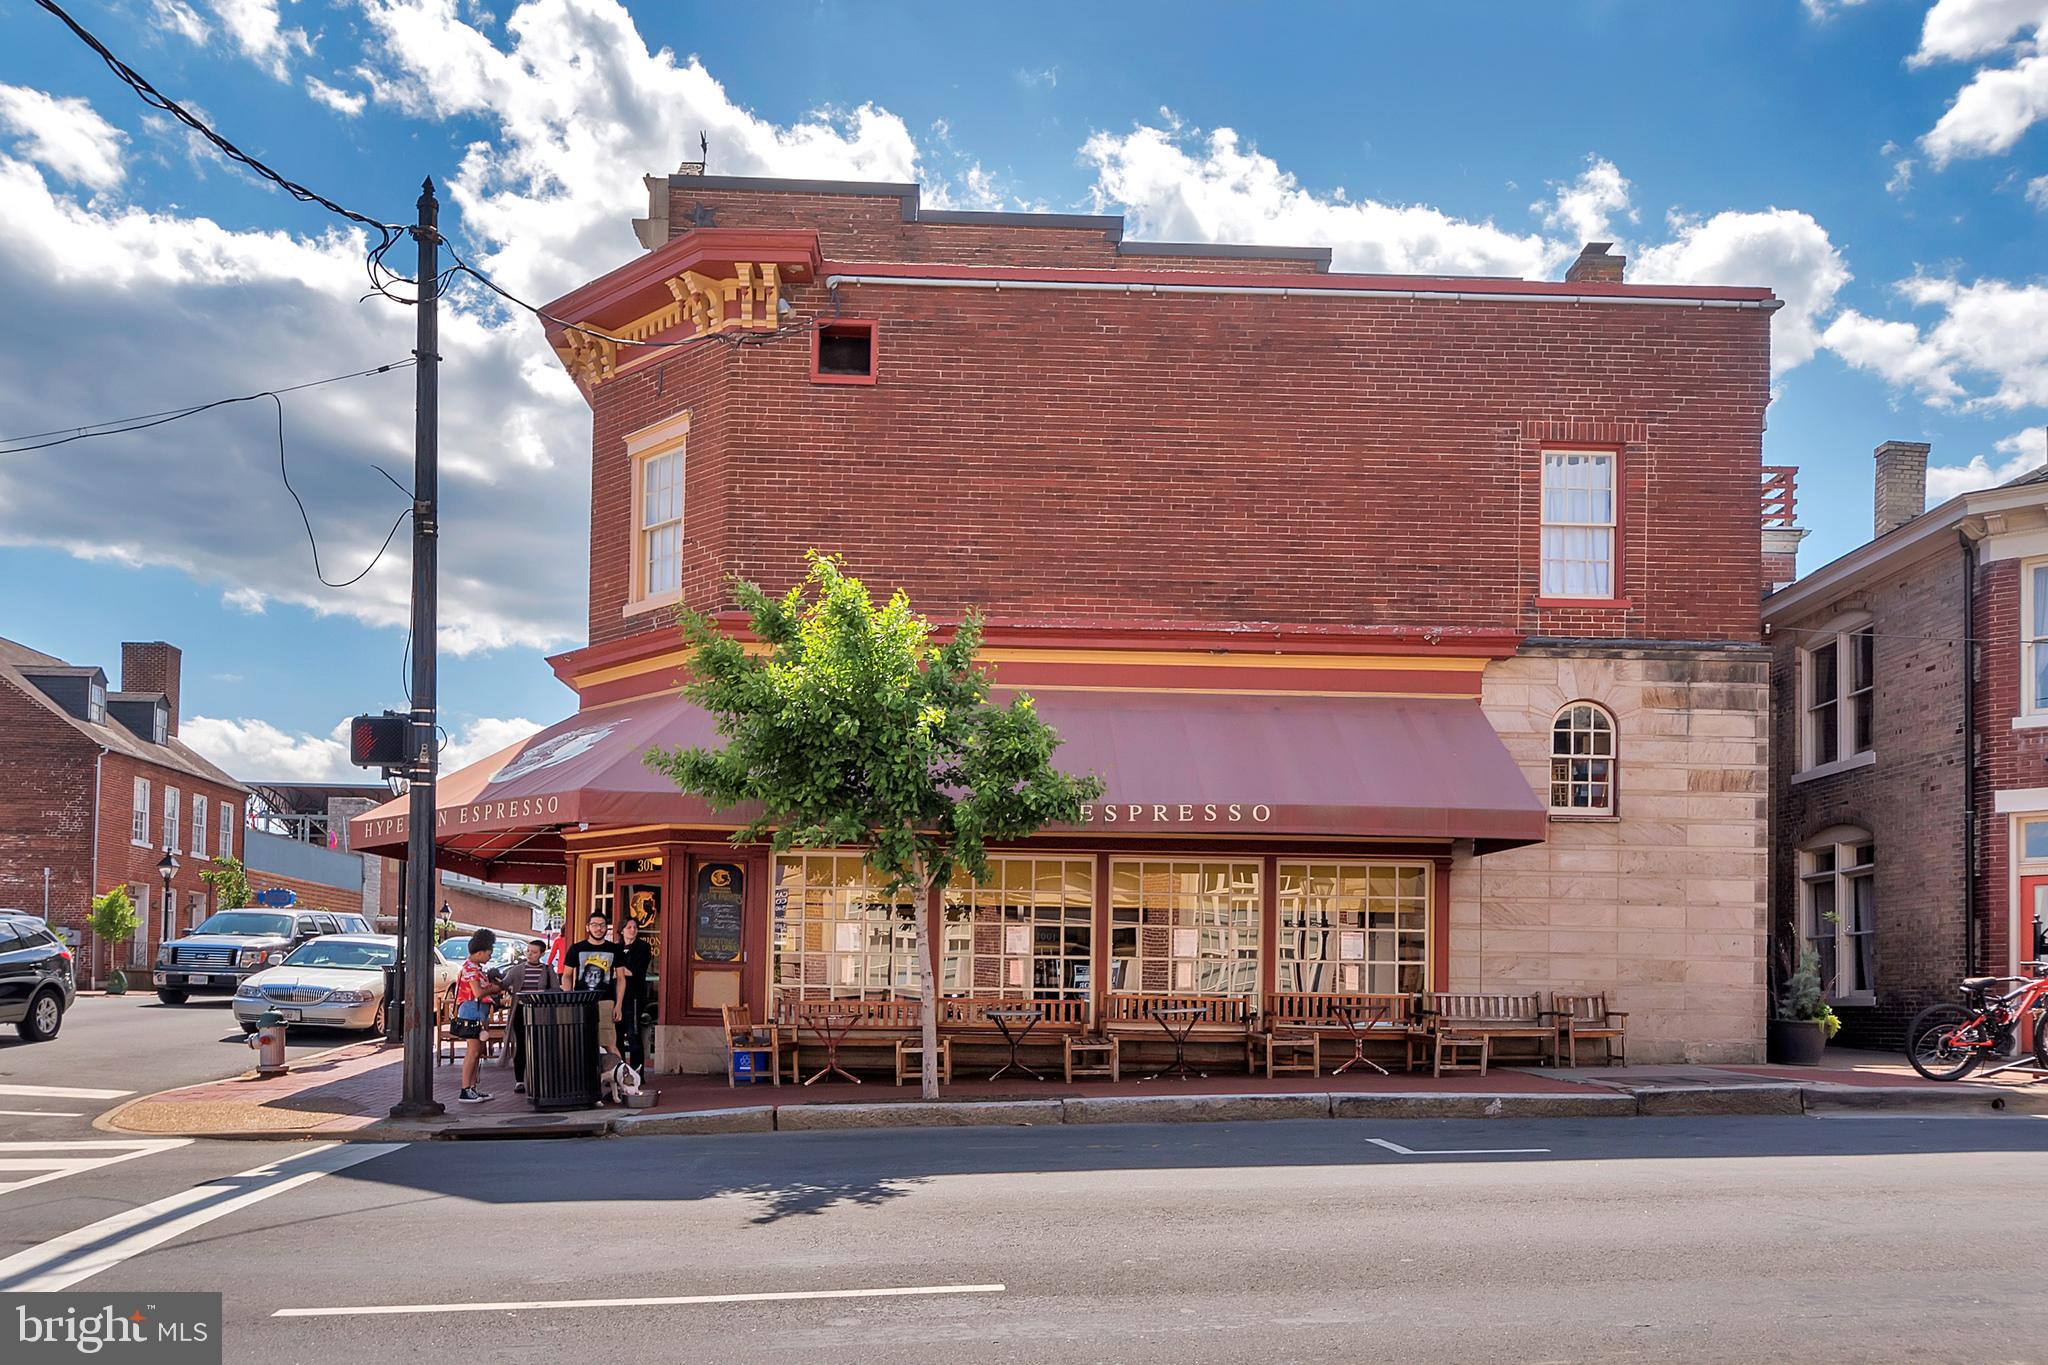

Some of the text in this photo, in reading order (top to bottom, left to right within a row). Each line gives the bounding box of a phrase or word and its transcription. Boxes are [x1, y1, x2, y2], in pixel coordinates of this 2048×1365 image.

[364, 796, 559, 838] HYPEN ESPRESSO
[1079, 803, 1271, 823] ESPRESSO
[637, 859, 654, 872] 301
